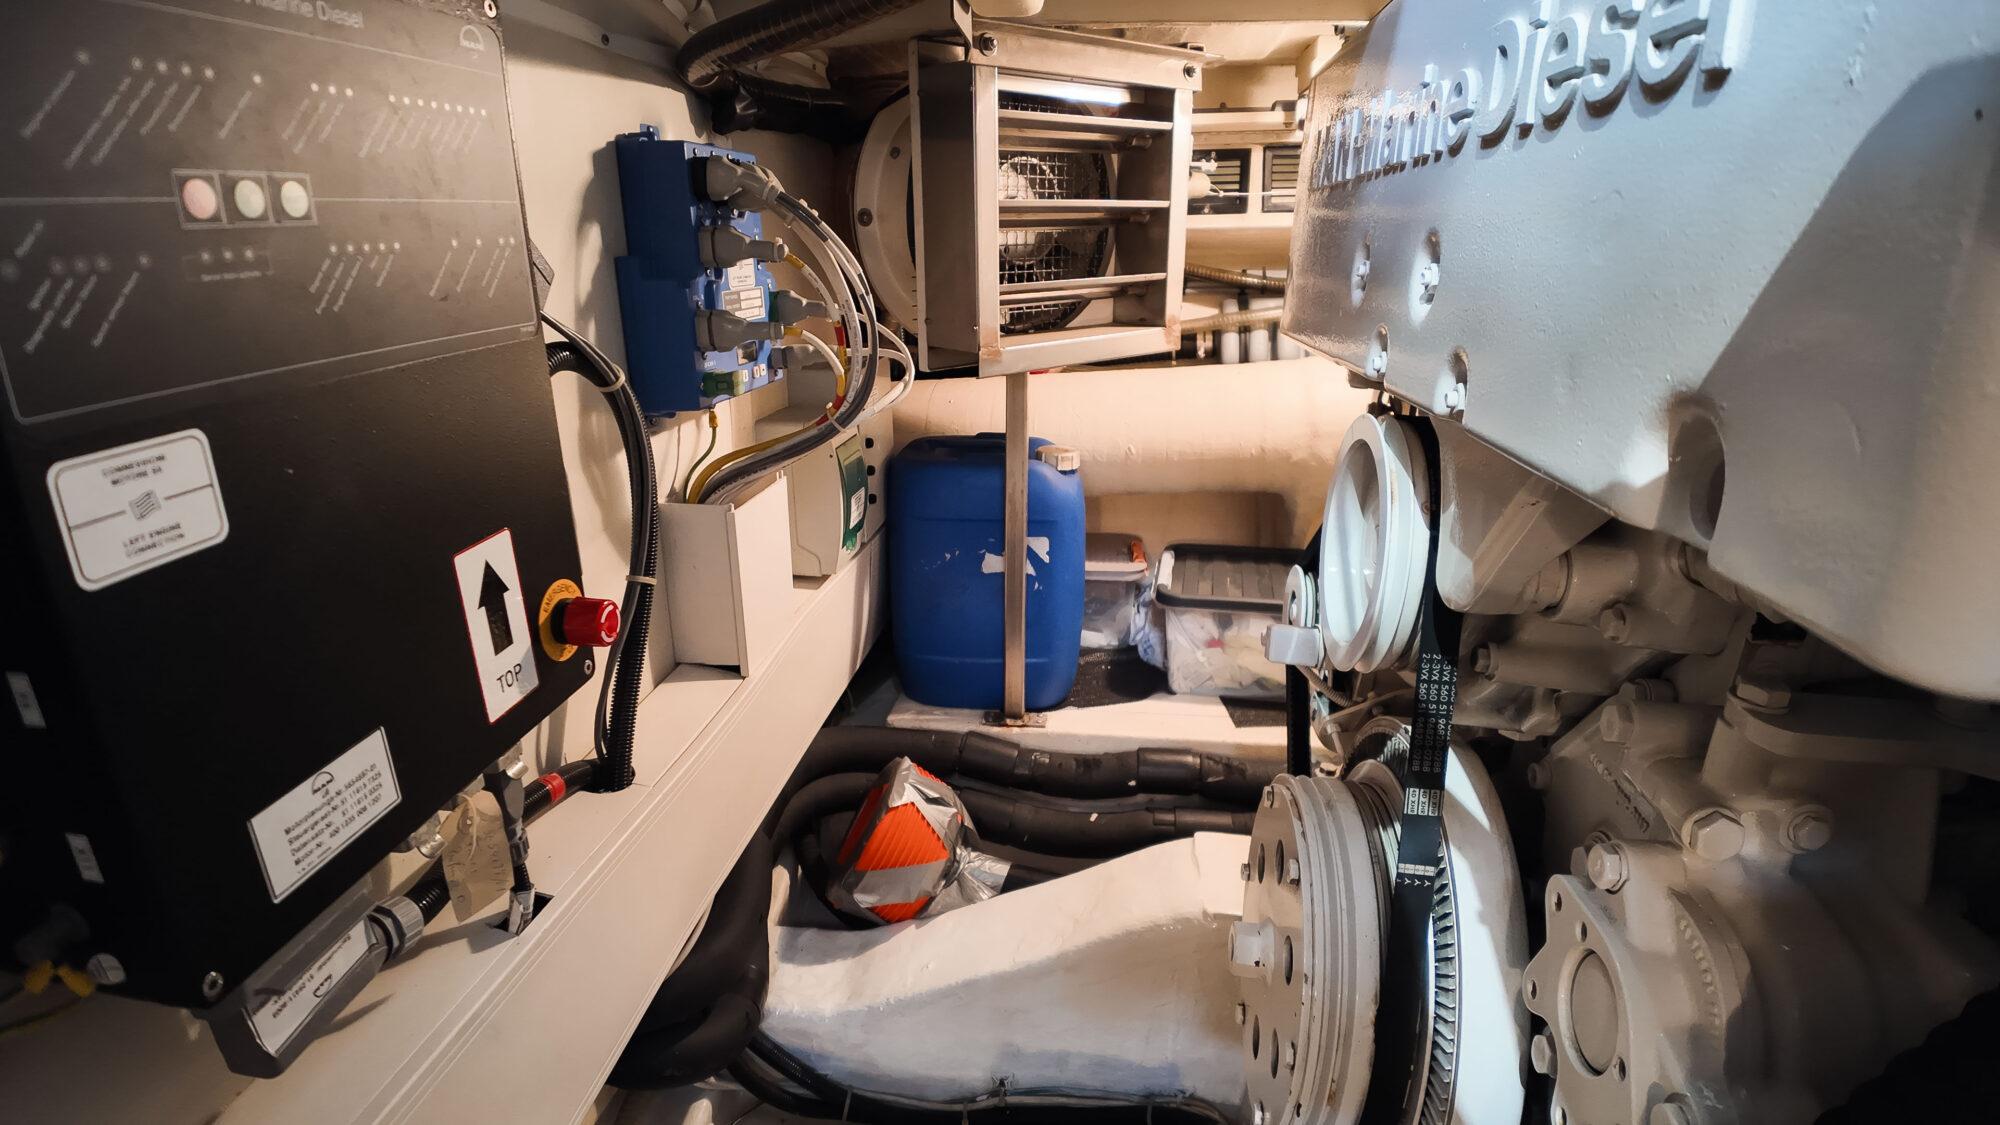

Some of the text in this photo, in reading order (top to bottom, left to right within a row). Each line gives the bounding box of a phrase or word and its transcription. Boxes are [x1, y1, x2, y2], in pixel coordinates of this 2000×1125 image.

[496, 663, 522, 693] TOP
[1419, 682, 1428, 700] 560
[1429, 683, 1438, 701] 560
[1440, 684, 1449, 702] 560
